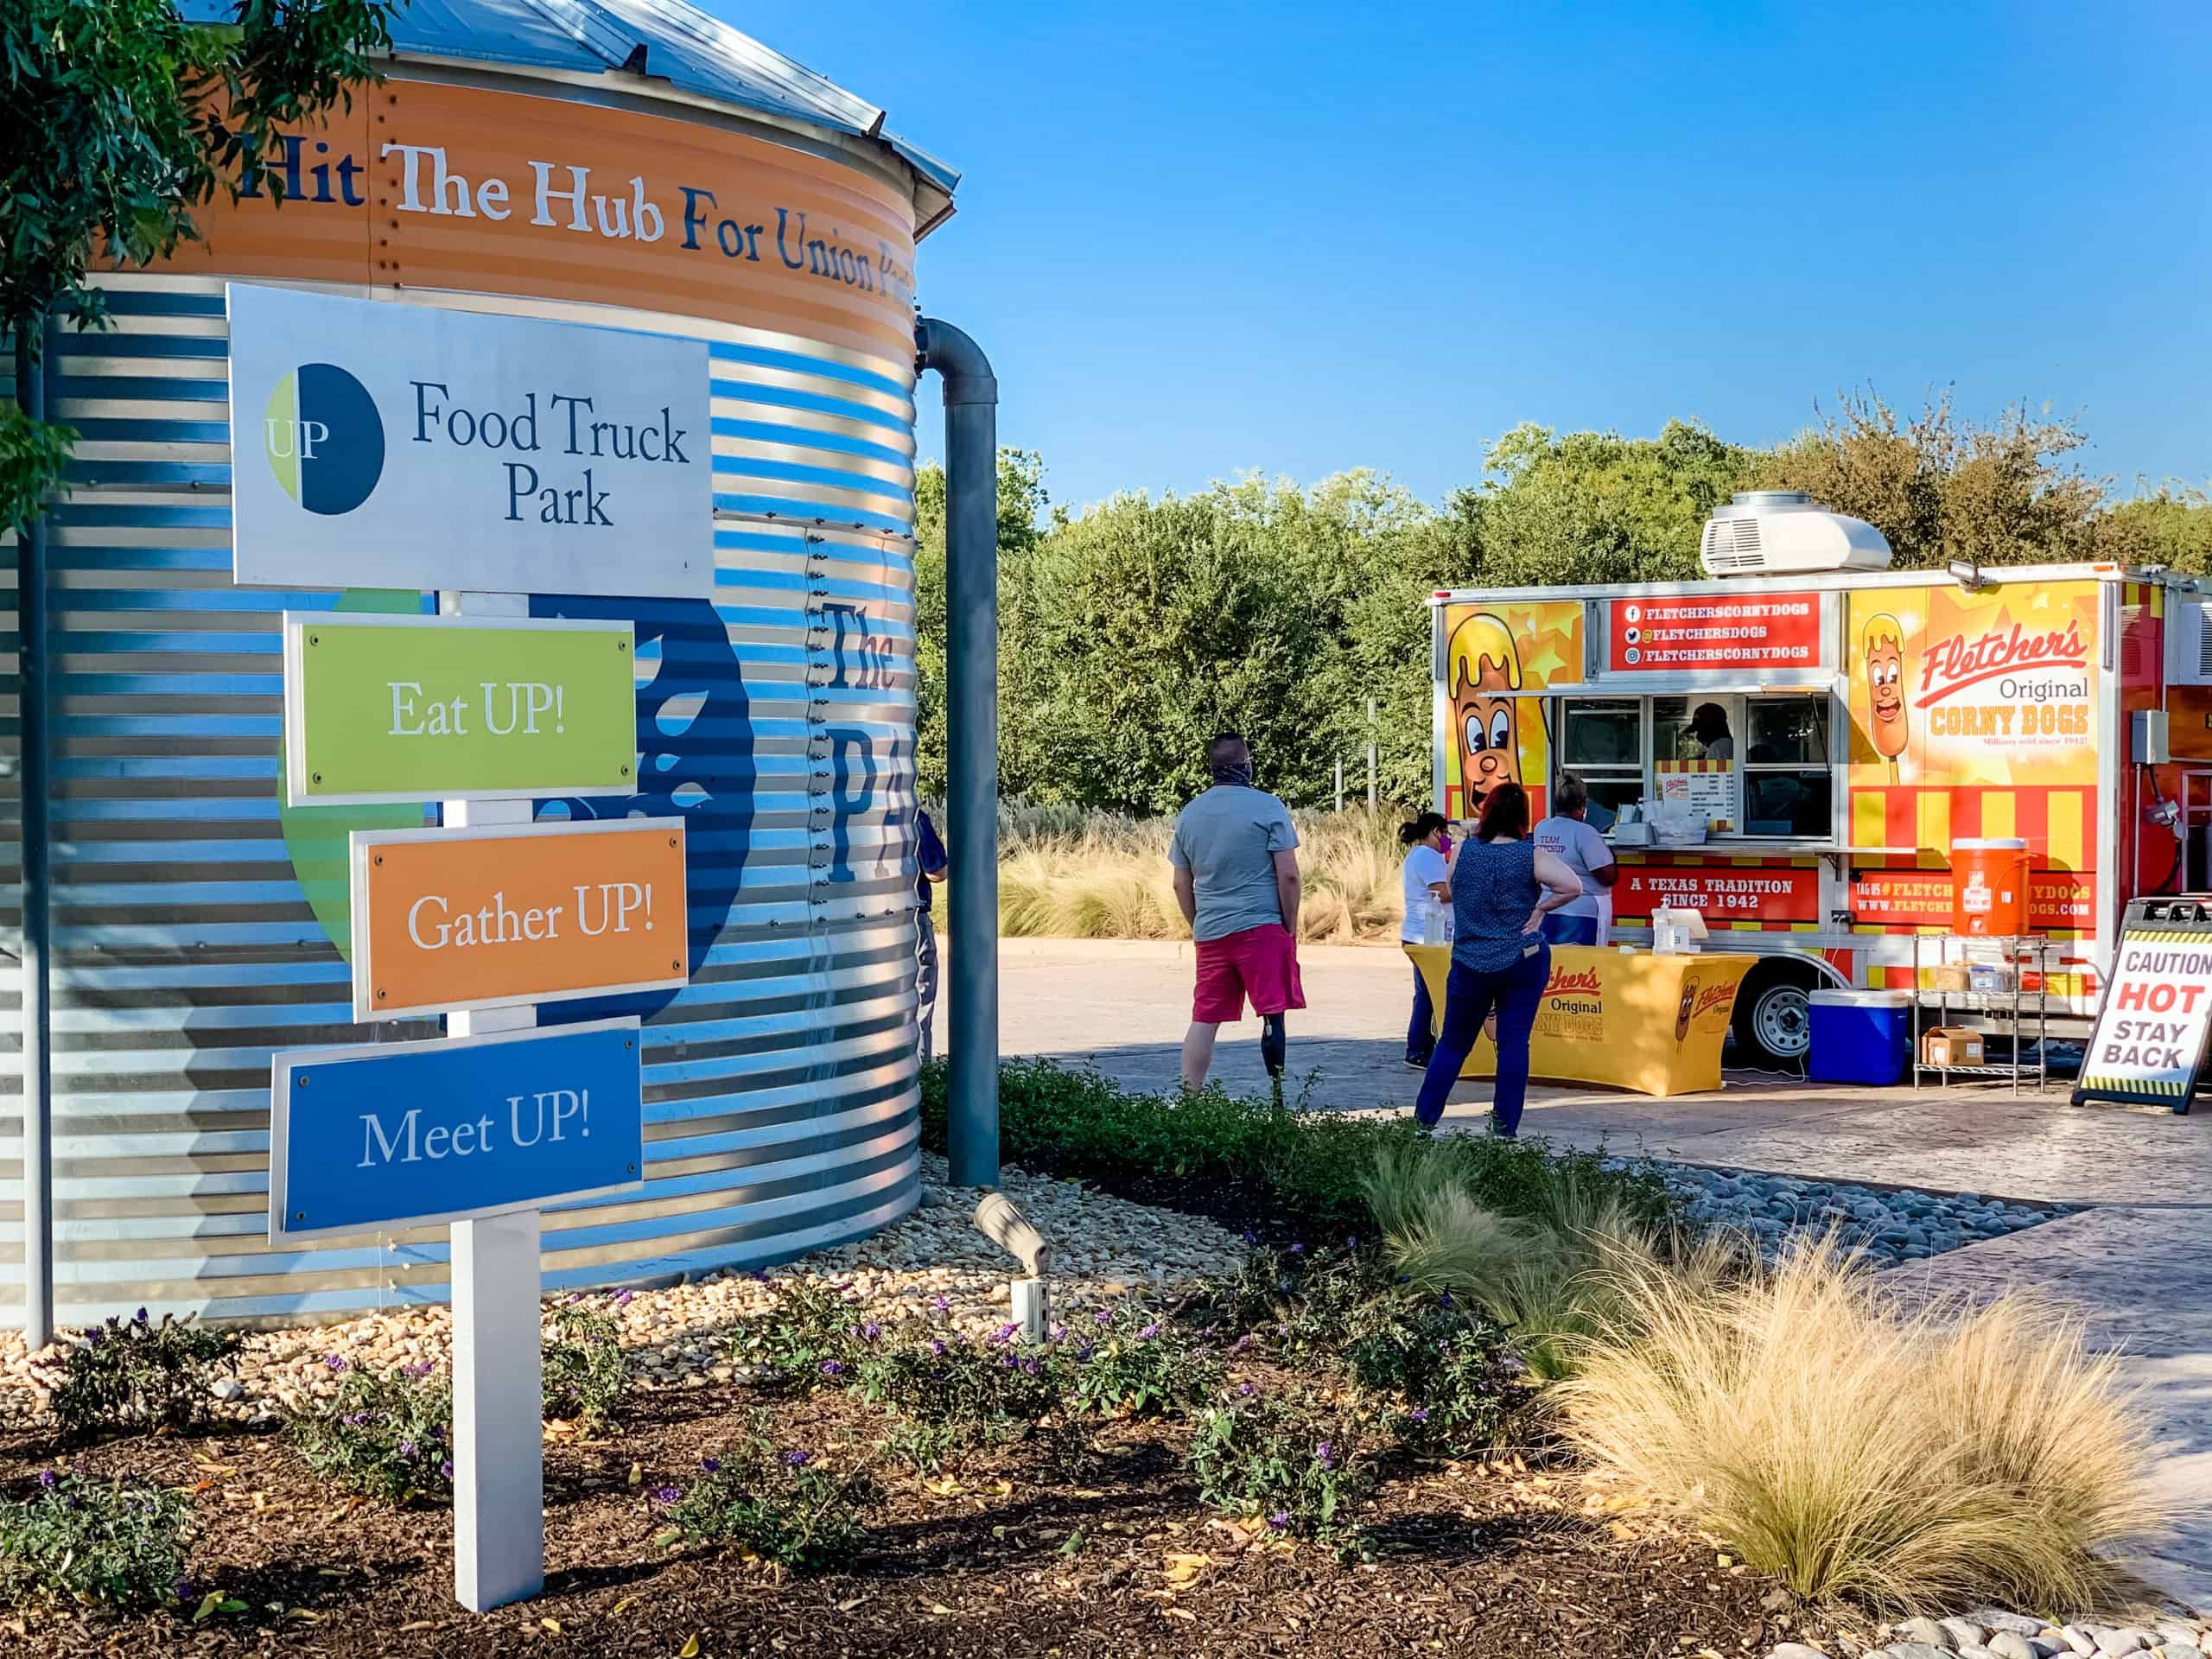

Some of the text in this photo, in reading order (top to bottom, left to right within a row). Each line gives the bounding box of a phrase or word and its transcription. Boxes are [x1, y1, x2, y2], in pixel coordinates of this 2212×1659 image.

[232, 131, 365, 207] Hit
[381, 143, 512, 221] The
[528, 160, 664, 242] Hub
[678, 186, 762, 263] For
[775, 207, 874, 292] Union
[265, 418, 329, 459] UP
[410, 381, 690, 464] Food Truck
[503, 462, 613, 526] Park
[822, 602, 895, 690] The
[1920, 619, 2088, 691] Fletcher's
[1999, 677, 2088, 702] Original
[386, 682, 565, 736] Eat UP!
[1930, 705, 2088, 735] CORNY DOGS
[1630, 877, 1793, 893] A TEXAS TRADITION
[1662, 893, 1758, 908] SINCE 1942
[408, 883, 654, 950] Gather UP!
[2126, 950, 2212, 976] CAUTION
[1551, 997, 1602, 1014] Original
[2116, 982, 2205, 1014] HOT
[2113, 1020, 2189, 1043] STAY
[2102, 1044, 2185, 1069] BACK
[357, 1090, 589, 1168] Meet UP!
